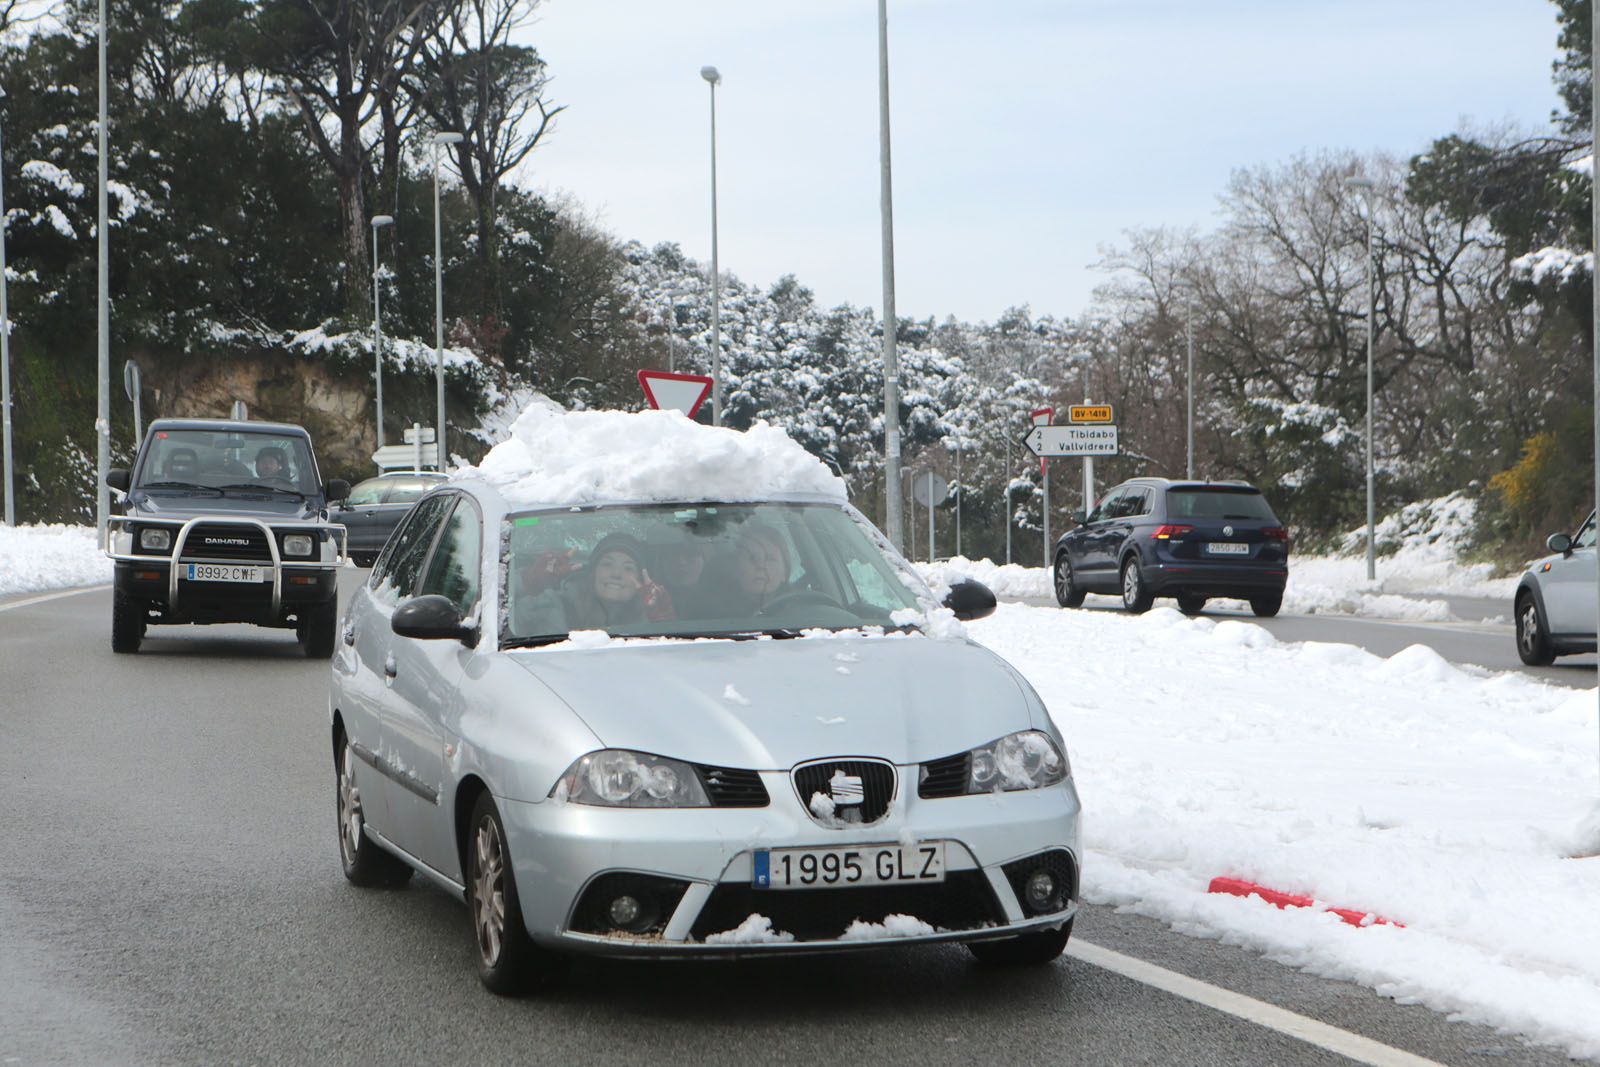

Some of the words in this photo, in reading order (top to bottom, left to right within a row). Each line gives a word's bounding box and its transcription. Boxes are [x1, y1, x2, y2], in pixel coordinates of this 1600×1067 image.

[1037, 431, 1042, 439] 2
[1069, 430, 1114, 439] Tibidabo
[1037, 443, 1042, 451] 2
[1059, 442, 1114, 451] Vallvidrera
[205, 537, 249, 545] DAIHATSU
[197, 566, 229, 579] 8992
[233, 568, 257, 580] CWF
[757, 874, 767, 884] E
[781, 852, 863, 885] 1995
[875, 847, 938, 881] GLZ
